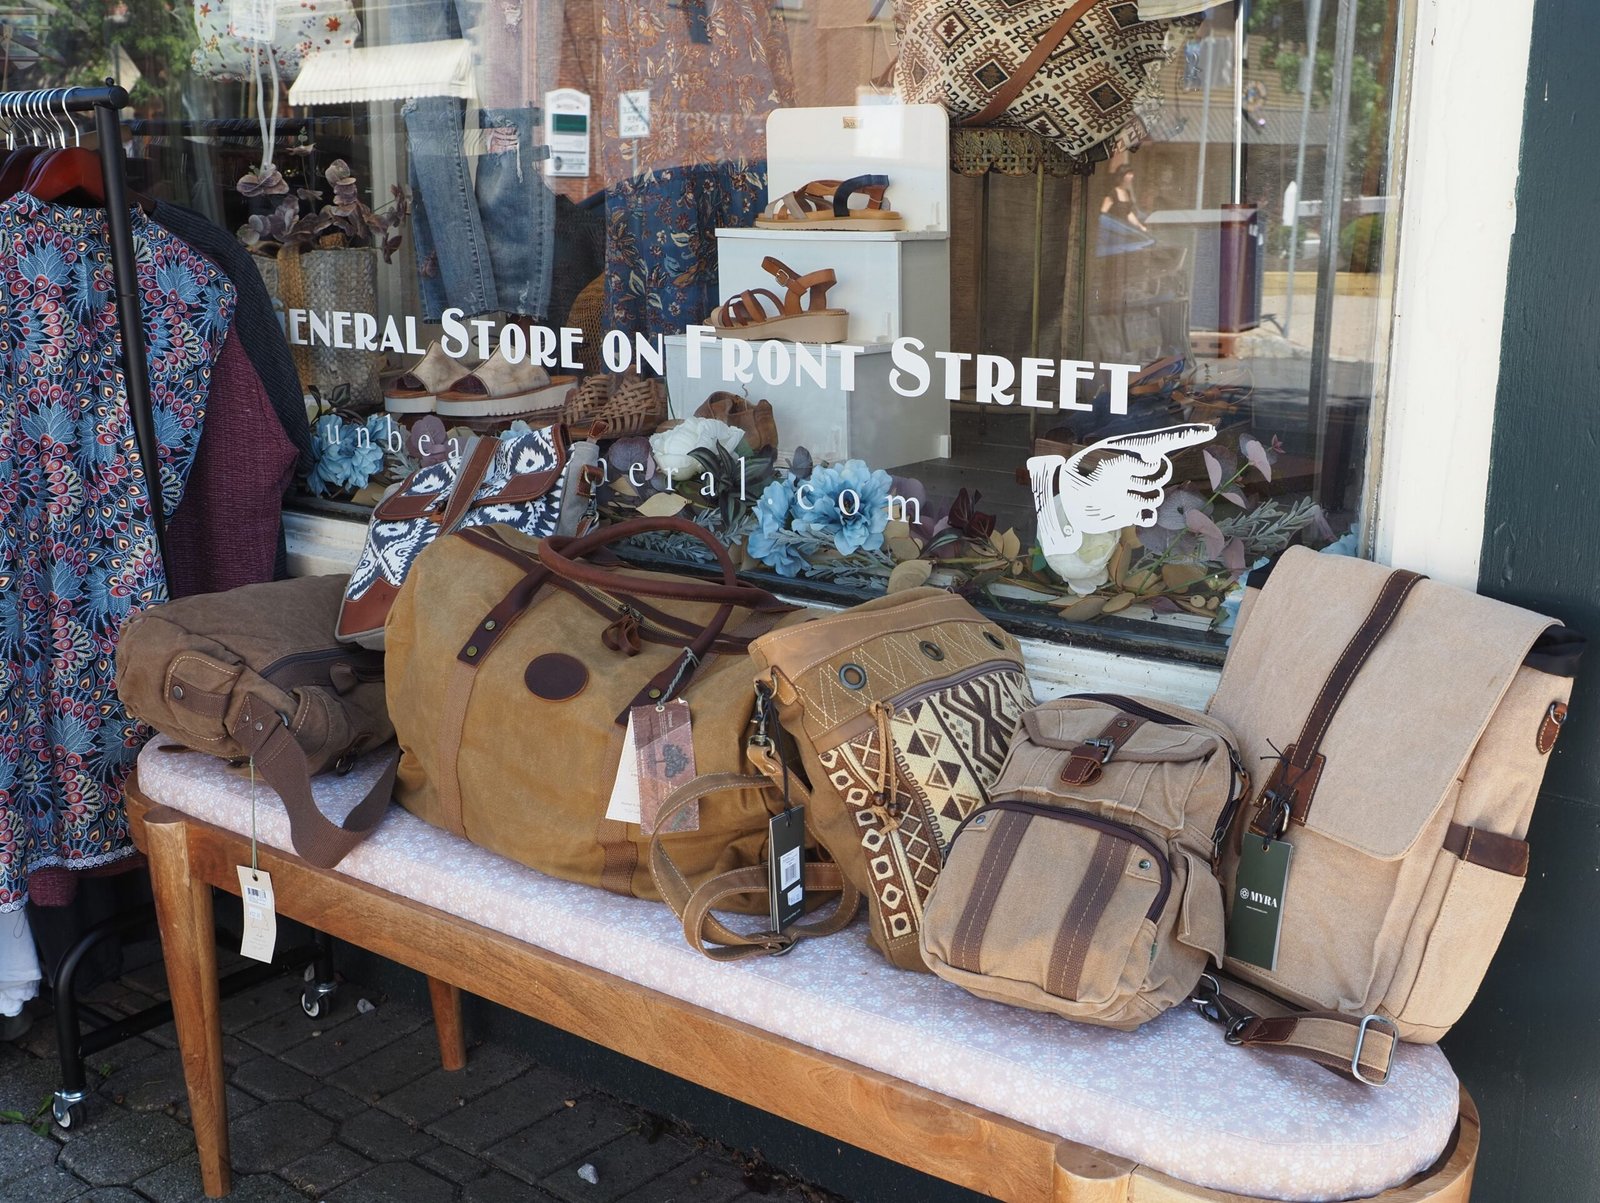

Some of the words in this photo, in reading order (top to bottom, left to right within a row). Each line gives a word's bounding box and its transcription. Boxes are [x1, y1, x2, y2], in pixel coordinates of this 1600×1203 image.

[288, 308, 425, 355] ENERAL
[441, 307, 584, 370] STORE
[602, 329, 664, 376] ON
[686, 324, 865, 391] FRONT
[889, 336, 1142, 415] STREET
[1250, 891, 1278, 908] MYRA
